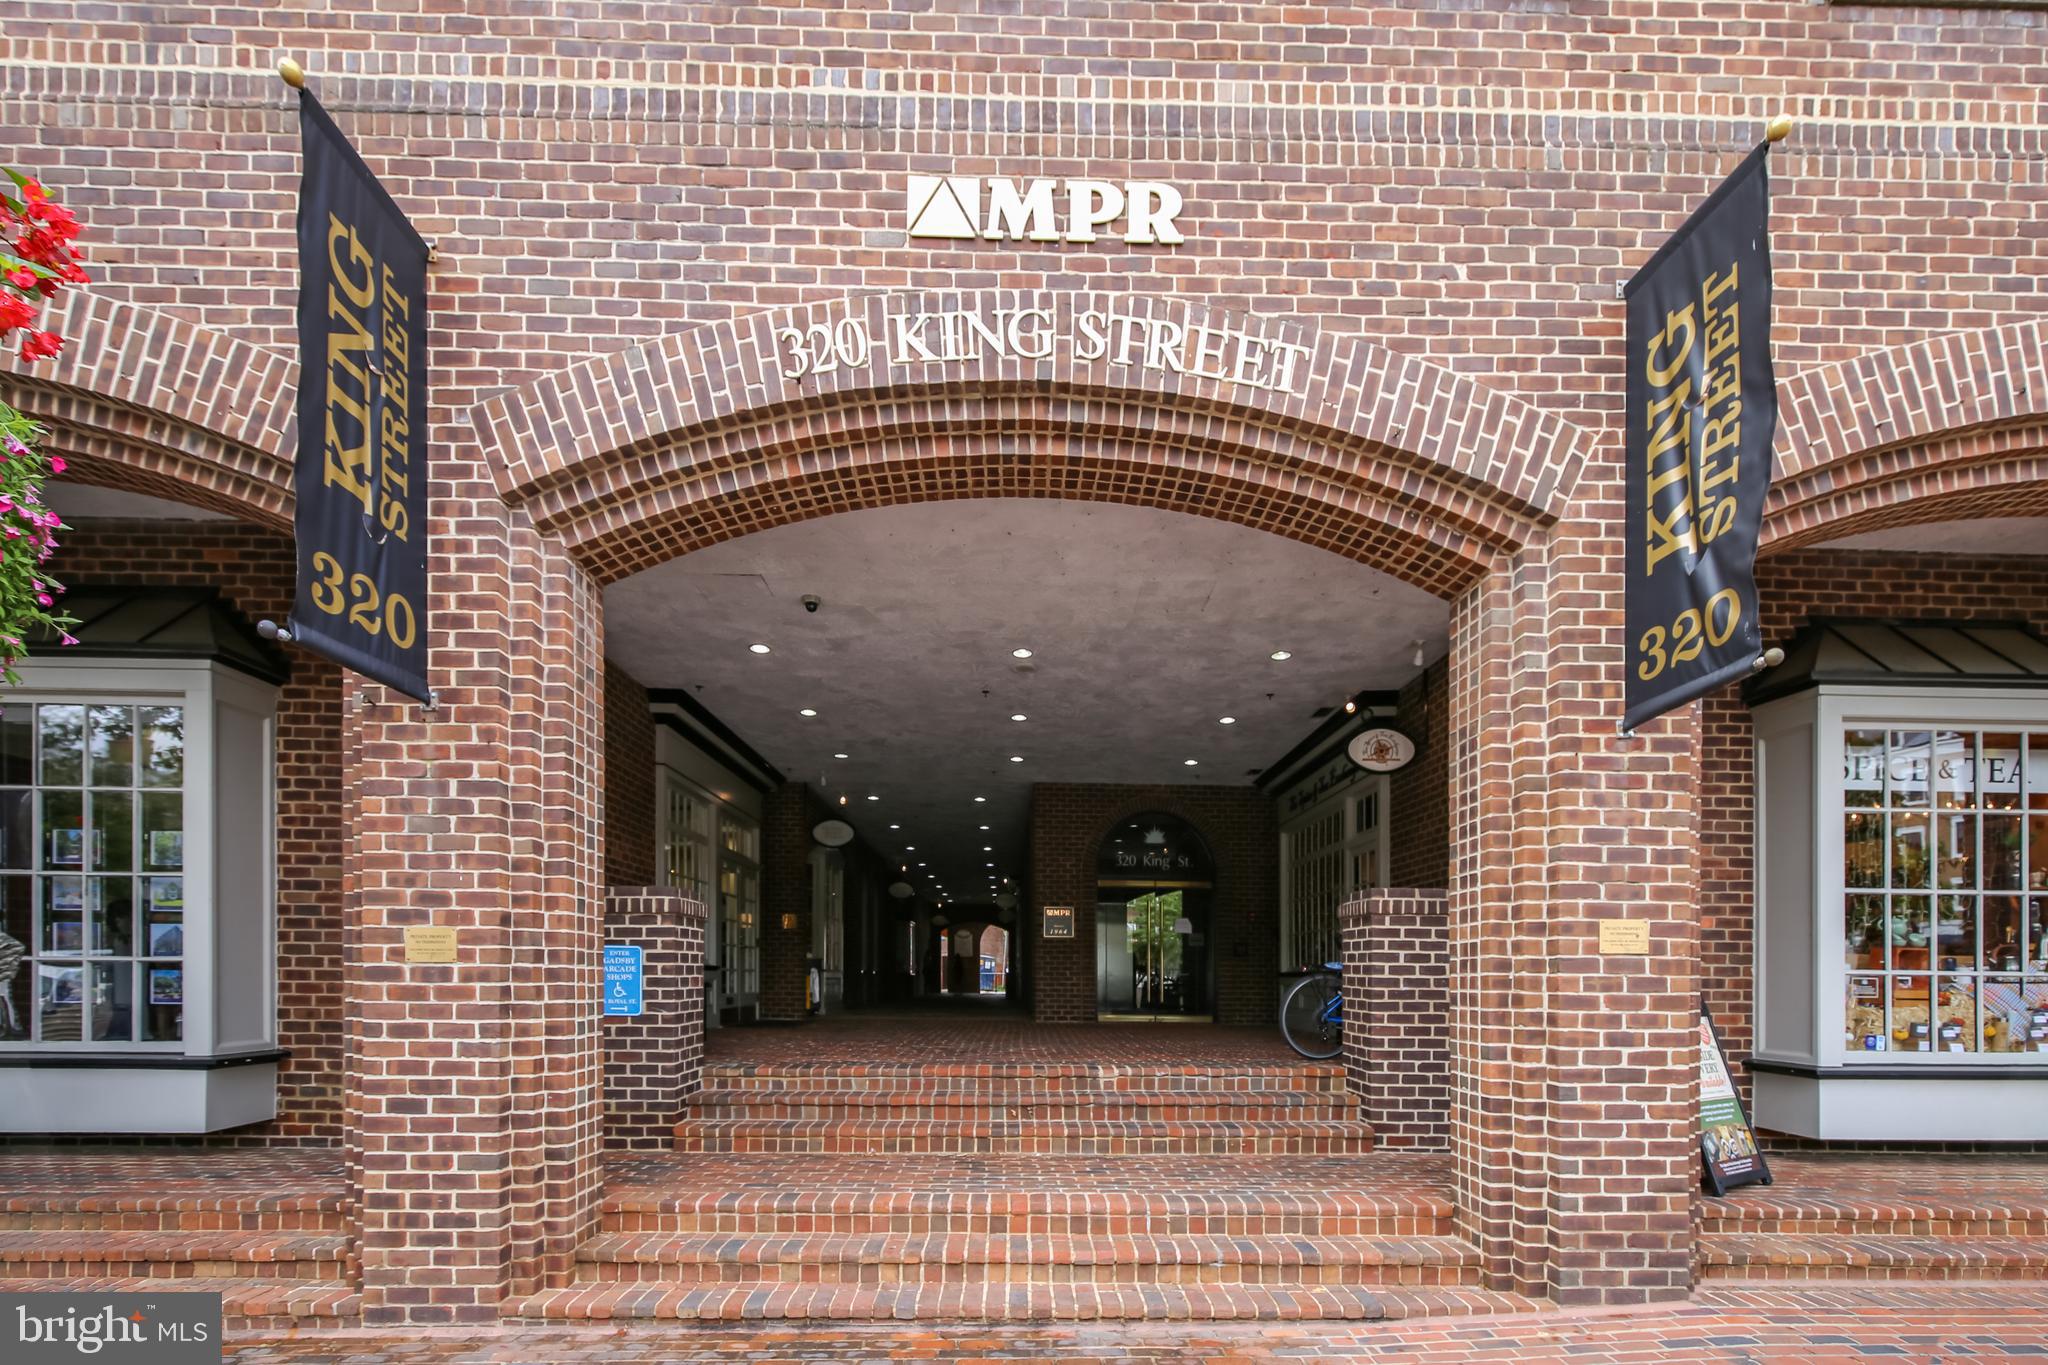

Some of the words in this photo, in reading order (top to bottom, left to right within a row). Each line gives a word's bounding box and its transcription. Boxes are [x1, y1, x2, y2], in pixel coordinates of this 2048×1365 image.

[984, 178, 1184, 244] MPR
[324, 211, 376, 517] KING
[780, 317, 868, 379] 320
[887, 308, 1056, 364] KING
[1074, 309, 1311, 394] STREET
[379, 261, 410, 543] STREET
[1645, 301, 1700, 577] KING
[1698, 261, 1743, 547] STREET
[311, 550, 417, 650] 320
[1637, 586, 1742, 682] 320
[1938, 759, 1955, 780] &
[1115, 854, 1137, 867] 320
[1142, 855, 1171, 871] King
[604, 965, 637, 973] ARCADE
[606, 973, 633, 981] SHOPS
